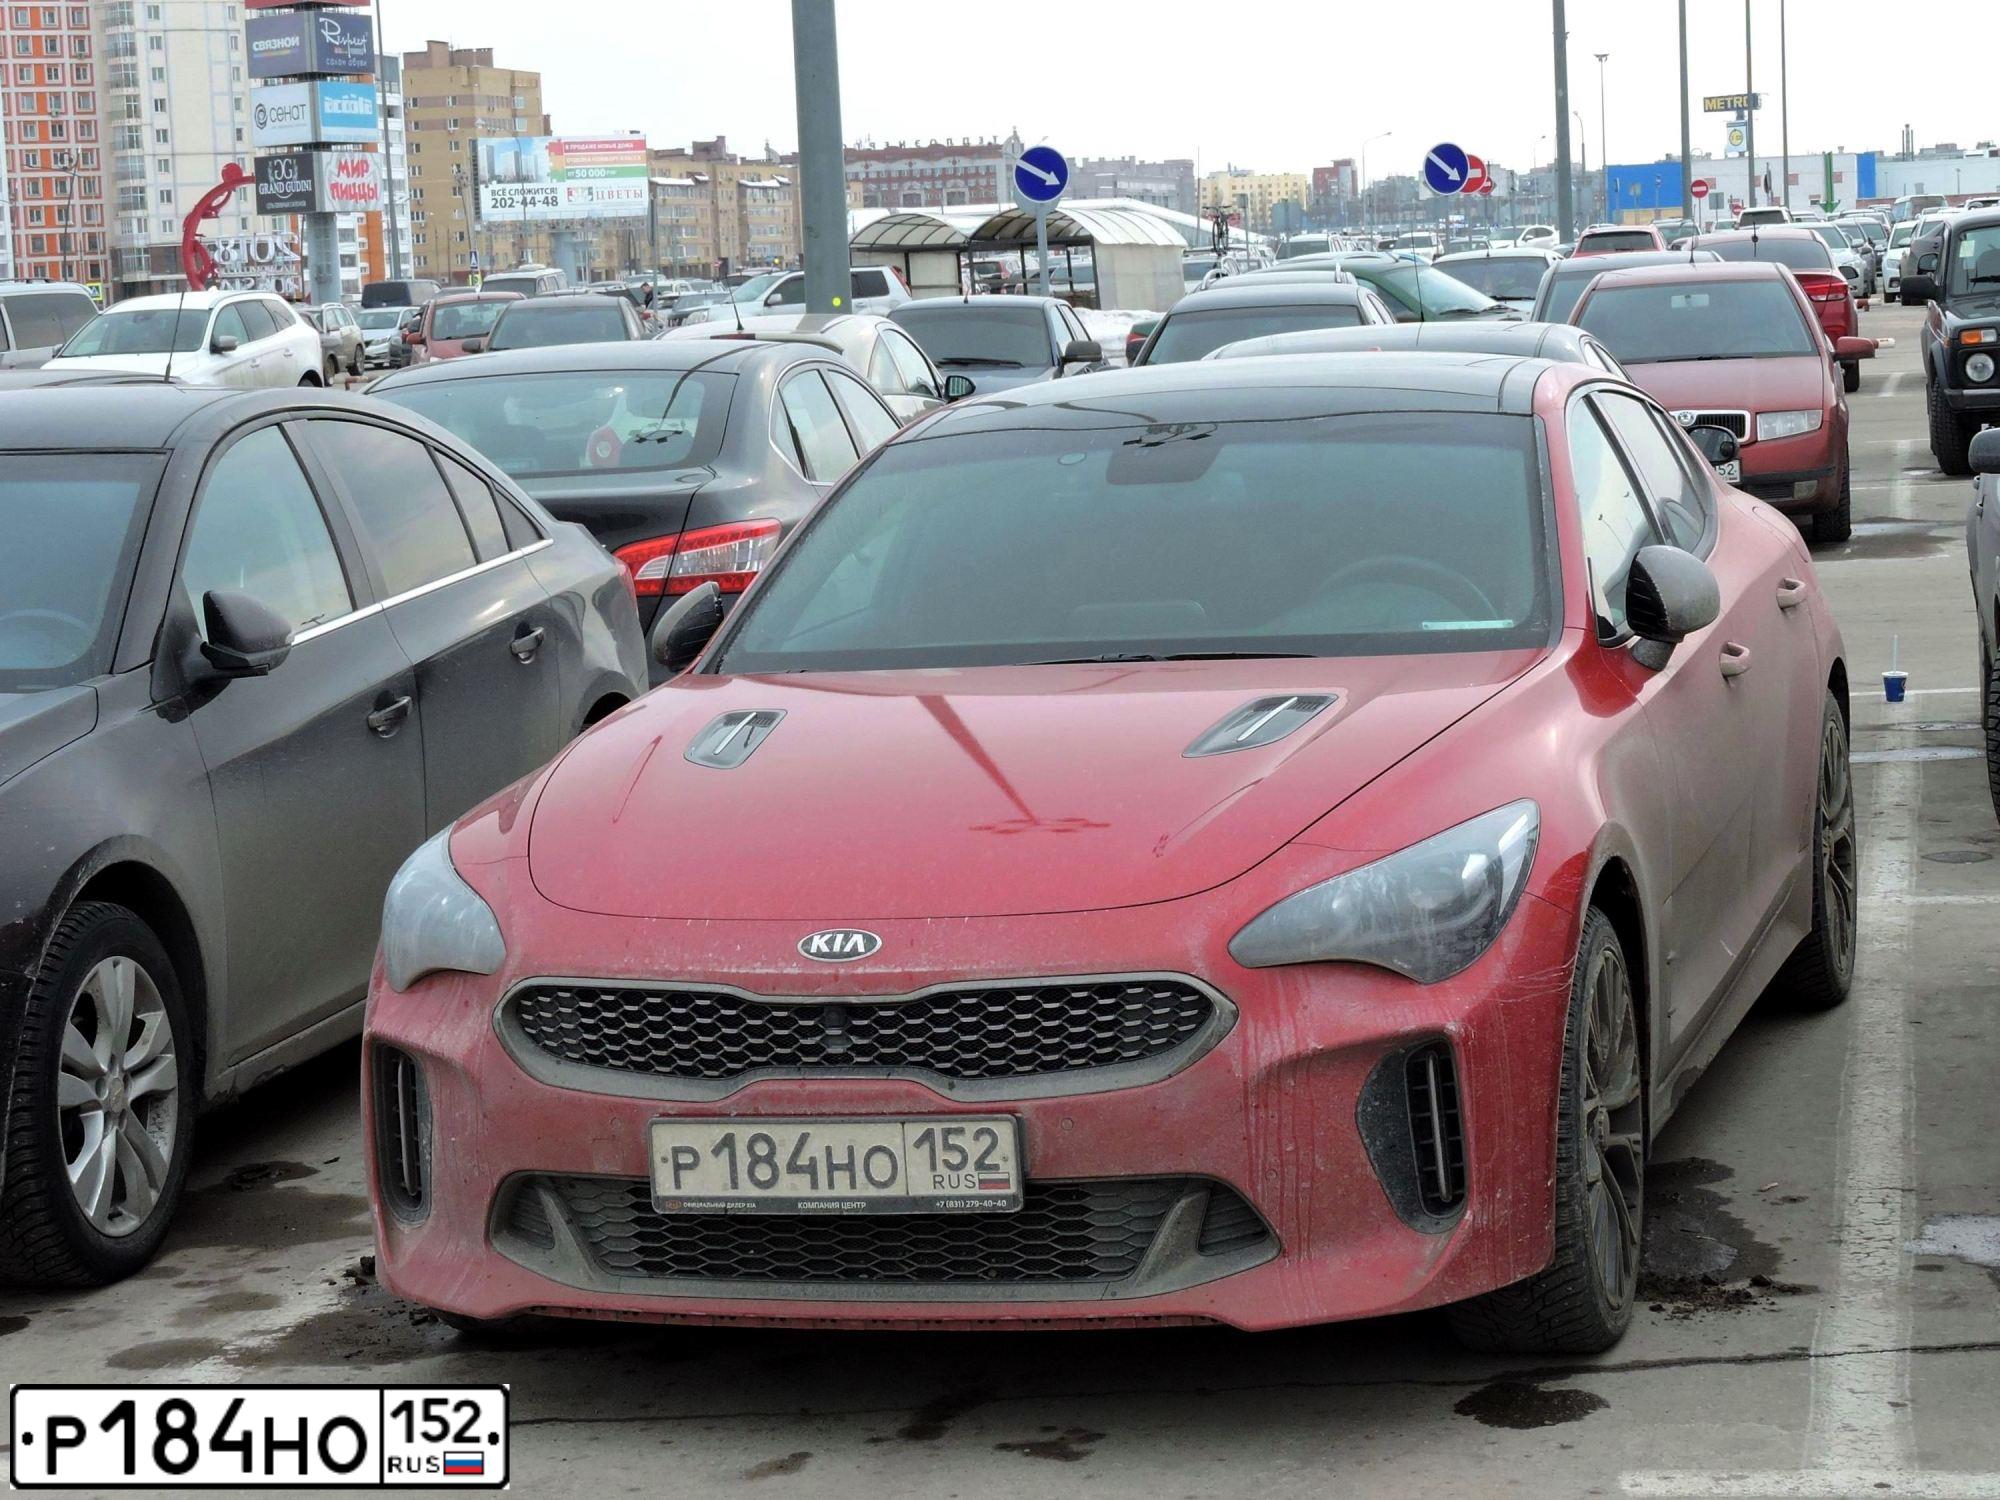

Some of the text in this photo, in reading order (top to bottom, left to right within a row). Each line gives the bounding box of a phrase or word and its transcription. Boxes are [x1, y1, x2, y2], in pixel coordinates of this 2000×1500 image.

[337, 159, 370, 178] МИР
[258, 182, 285, 195] GRAND
[329, 182, 379, 203] ПИЦЦЫ
[508, 187, 558, 196] СЛОЖИТСЯ!
[596, 189, 643, 201] ЦВЕТЫ
[491, 196, 559, 209] 202-44-48
[810, 933, 866, 953] KIA
[912, 1126, 1000, 1173] 152
[933, 1174, 977, 1190] RUS
[797, 1201, 867, 1210] КОМПАНИЯ ЦЕНТР
[946, 1200, 965, 1208] (831)
[966, 1200, 1007, 1208] 279-40-40
